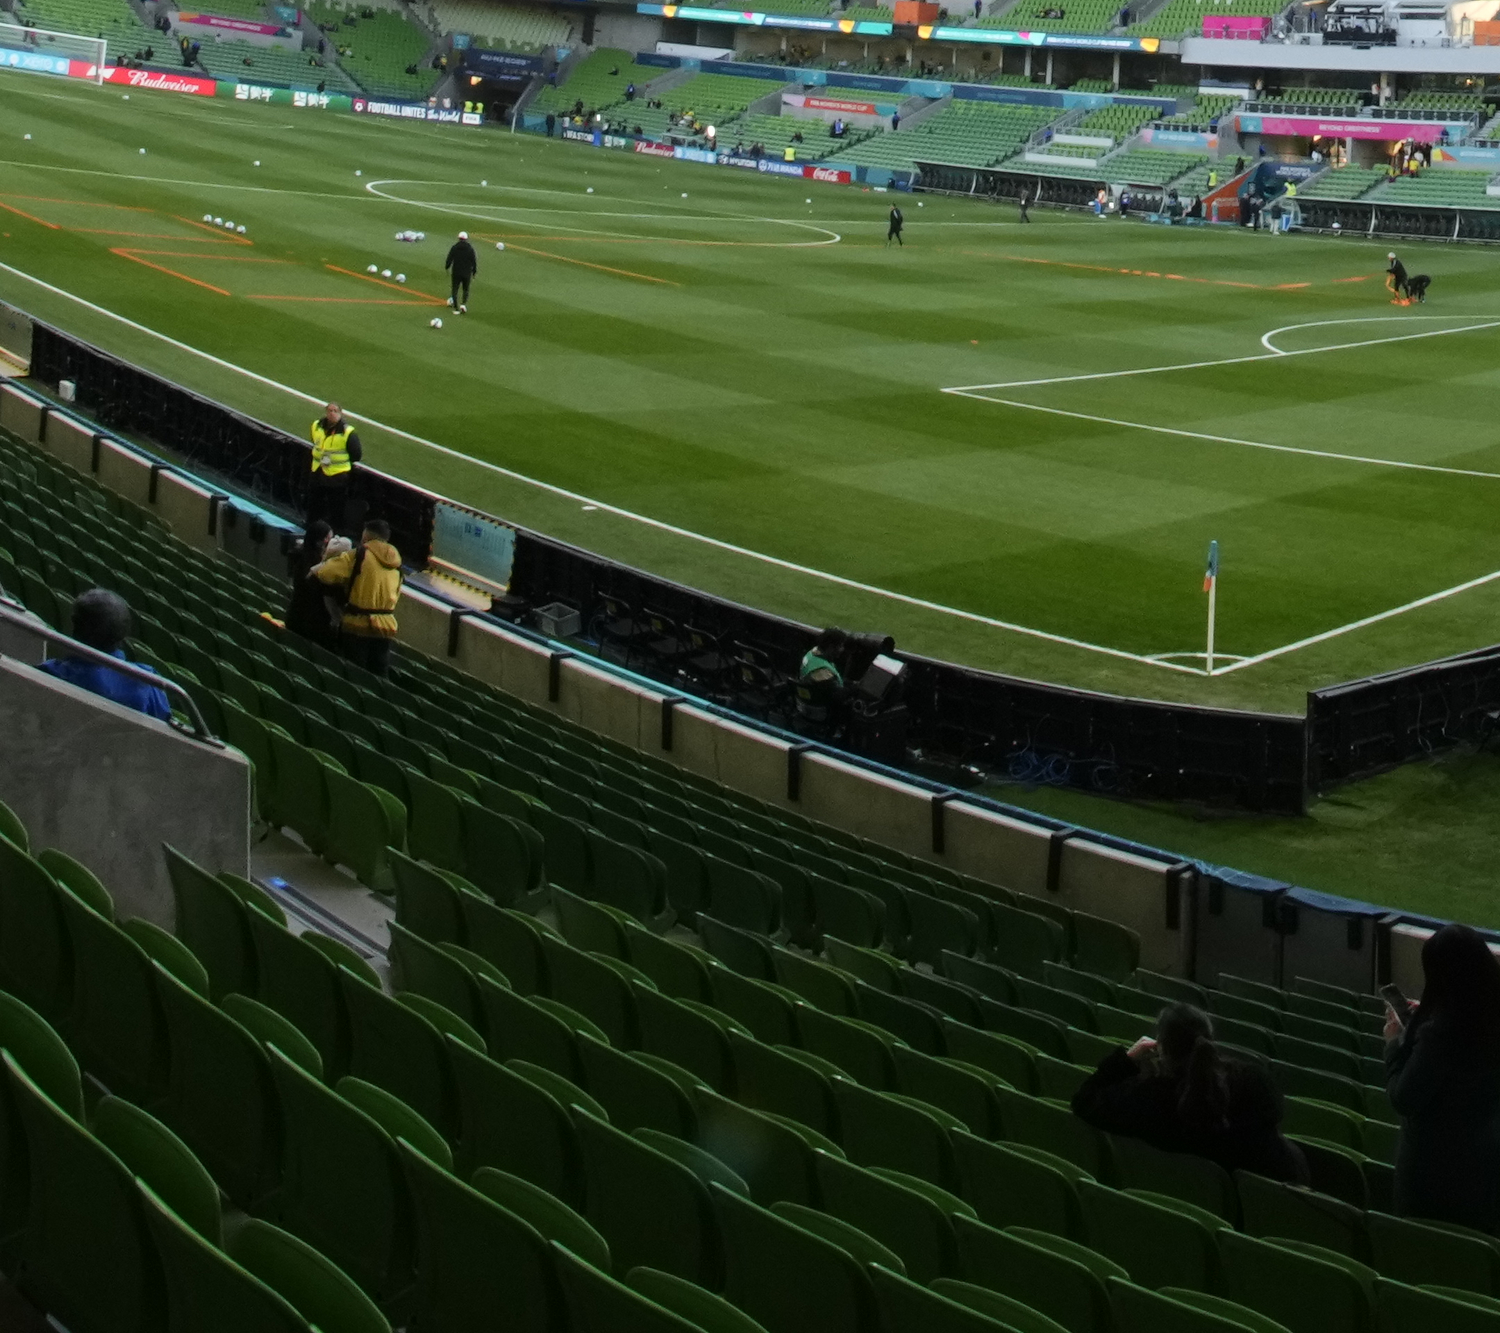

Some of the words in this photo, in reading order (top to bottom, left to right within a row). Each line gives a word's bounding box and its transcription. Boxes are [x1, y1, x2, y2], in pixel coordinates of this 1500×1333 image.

[128, 69, 200, 94] Budweiser
[368, 101, 401, 116] FOOTBALL
[401, 105, 426, 119] UNITES
